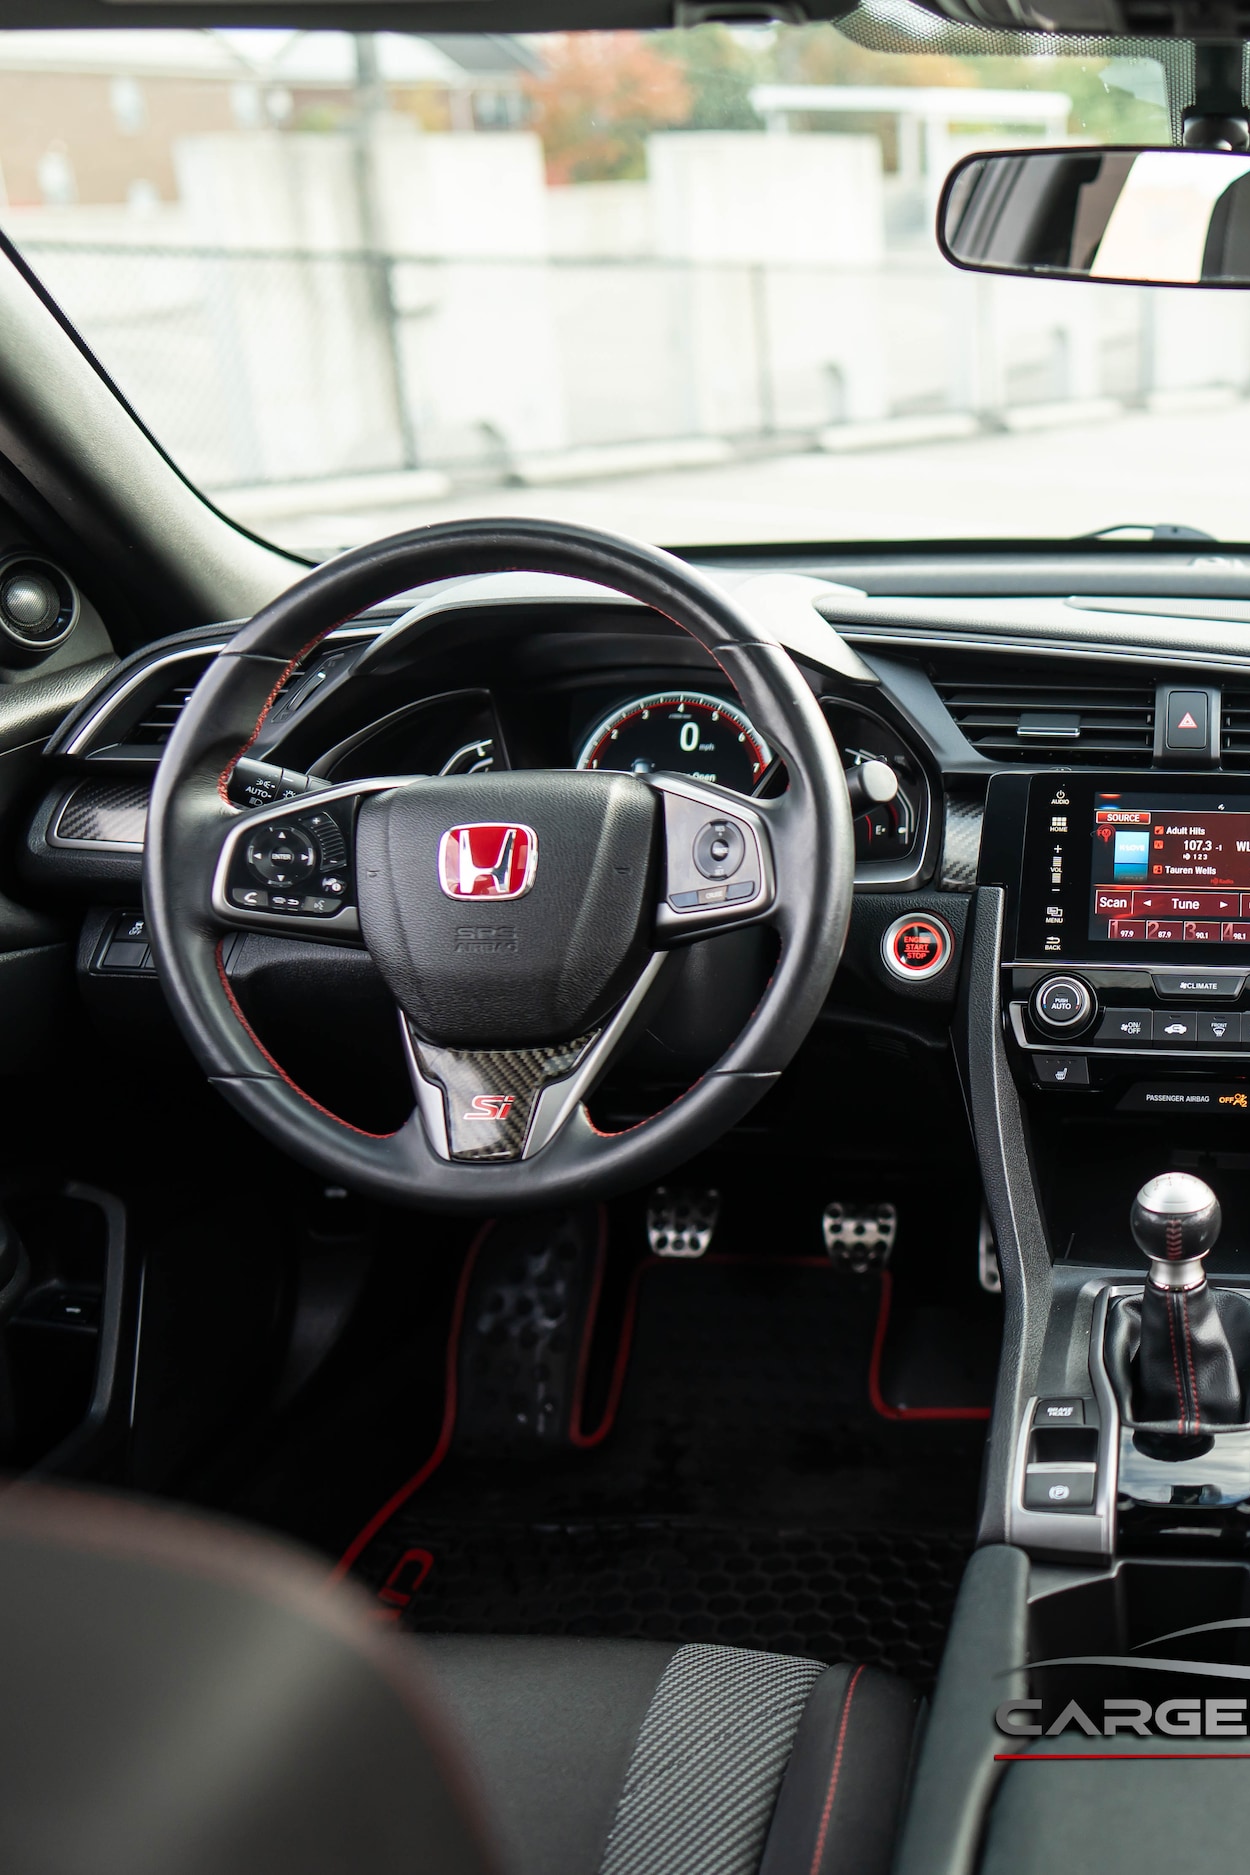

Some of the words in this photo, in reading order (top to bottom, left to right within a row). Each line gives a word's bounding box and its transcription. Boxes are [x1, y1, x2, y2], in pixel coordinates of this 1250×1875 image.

[679, 722, 699, 751] 0
[1106, 814, 1140, 823] SOURCE
[1166, 827, 1187, 835] Adult
[1189, 827, 1206, 836] Hits
[1183, 840, 1212, 851] 107.3
[1165, 866, 1193, 874] Tauren
[1195, 866, 1217, 875] Wells
[1099, 897, 1127, 908] Scan
[1171, 898, 1200, 910] Tune
[1120, 930, 1134, 938] 97.9
[1158, 931, 1172, 939] 87.9
[1146, 1094, 1184, 1102] PASSENGER
[1218, 1096, 1234, 1104] OFF
[463, 1094, 516, 1120] Si
